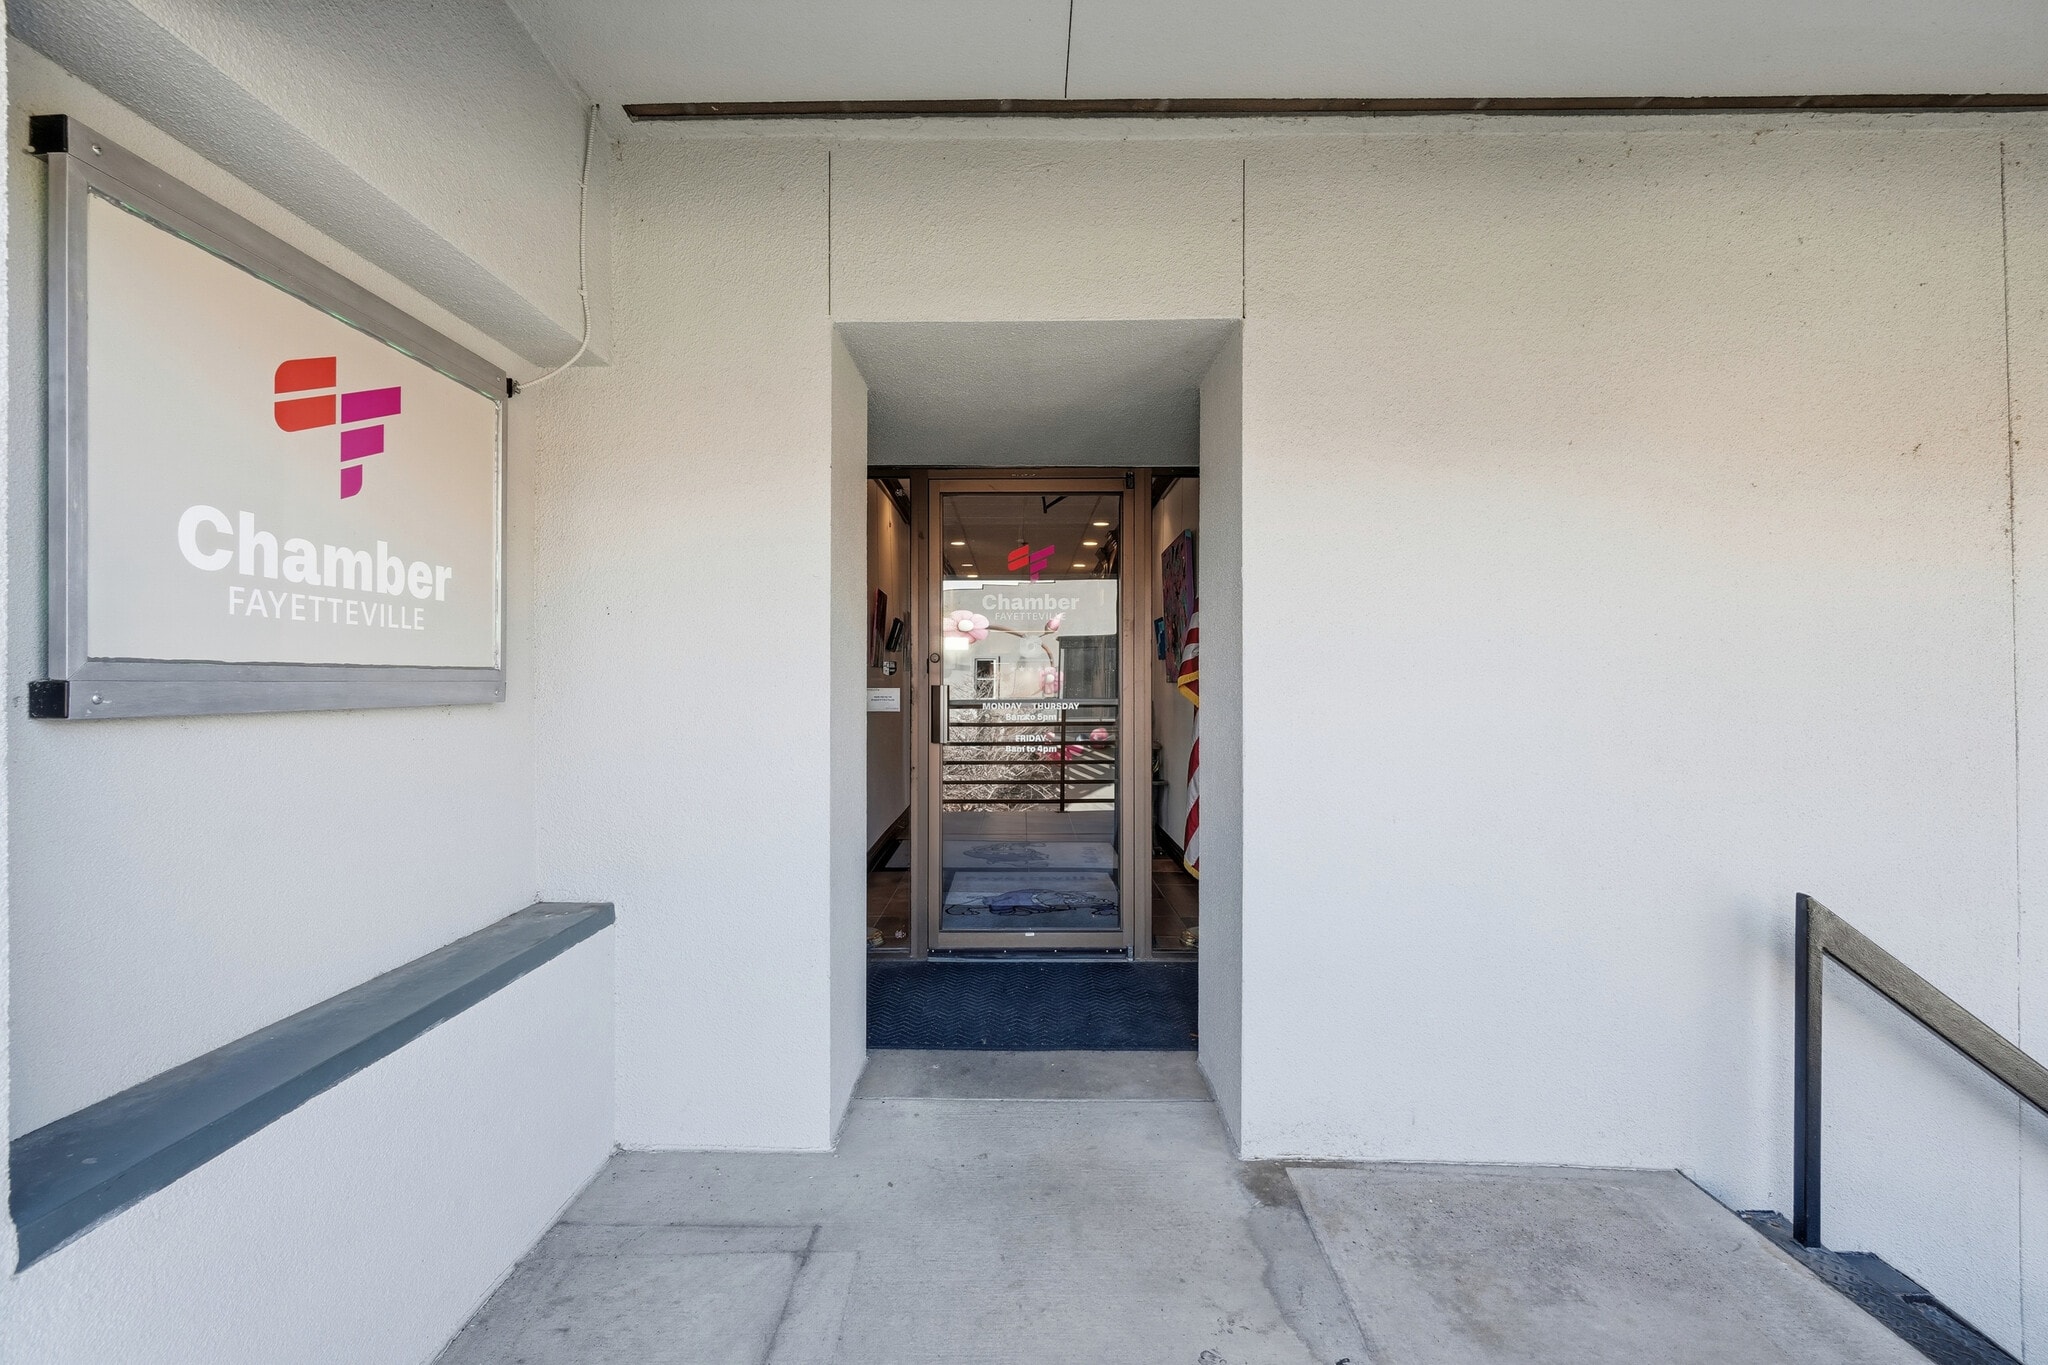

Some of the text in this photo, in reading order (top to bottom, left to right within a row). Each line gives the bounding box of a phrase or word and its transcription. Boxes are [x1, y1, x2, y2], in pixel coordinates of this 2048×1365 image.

[178, 504, 452, 601] Chamber
[982, 593, 1080, 610] Chamber
[228, 586, 425, 630] FAYETTEVILLE
[995, 612, 1067, 621] FAYETTEVILE
[982, 702, 1080, 710] MONDAY THURSDAY
[1015, 734, 1047, 742] FRIDAY
[1037, 745, 1057, 755] 4pm
